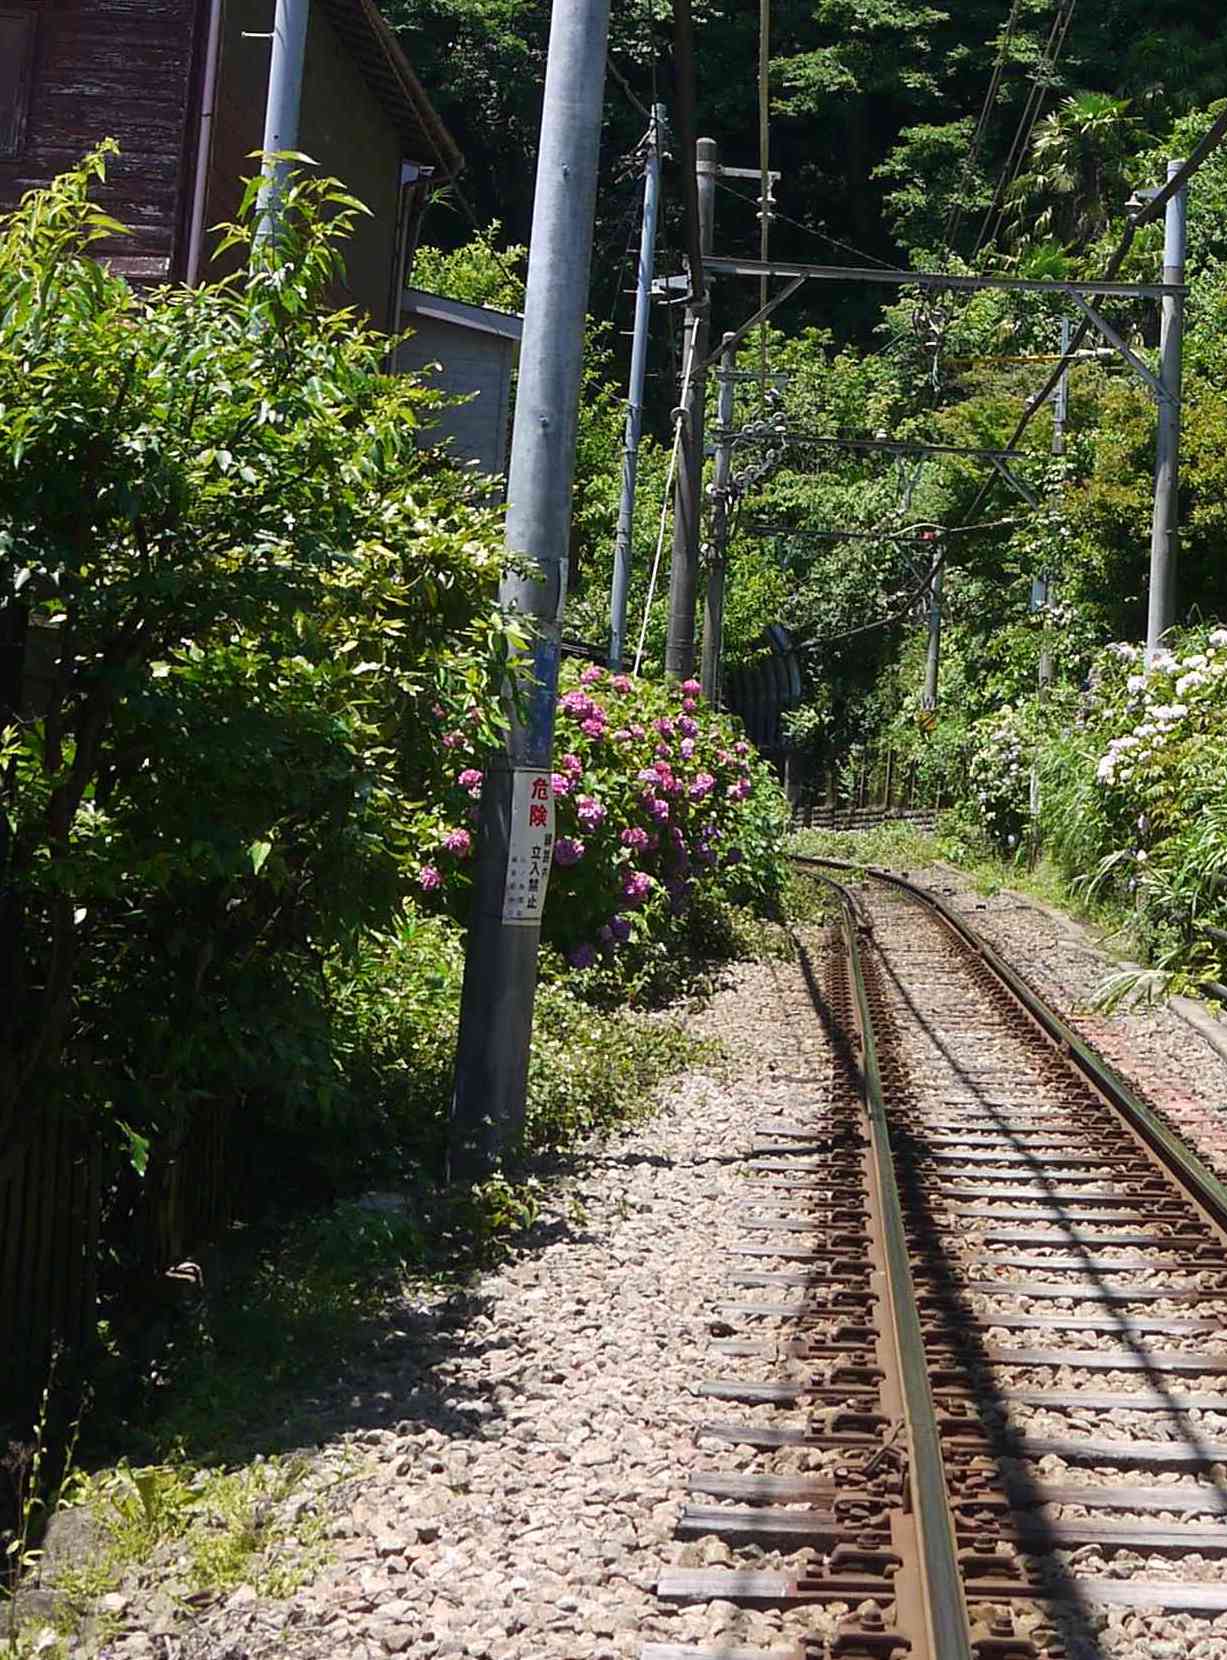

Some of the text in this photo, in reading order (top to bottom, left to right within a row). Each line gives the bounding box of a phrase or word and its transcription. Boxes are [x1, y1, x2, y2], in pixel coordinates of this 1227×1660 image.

[529, 777, 549, 828] 危険
[527, 845, 541, 909] 立入禁止
